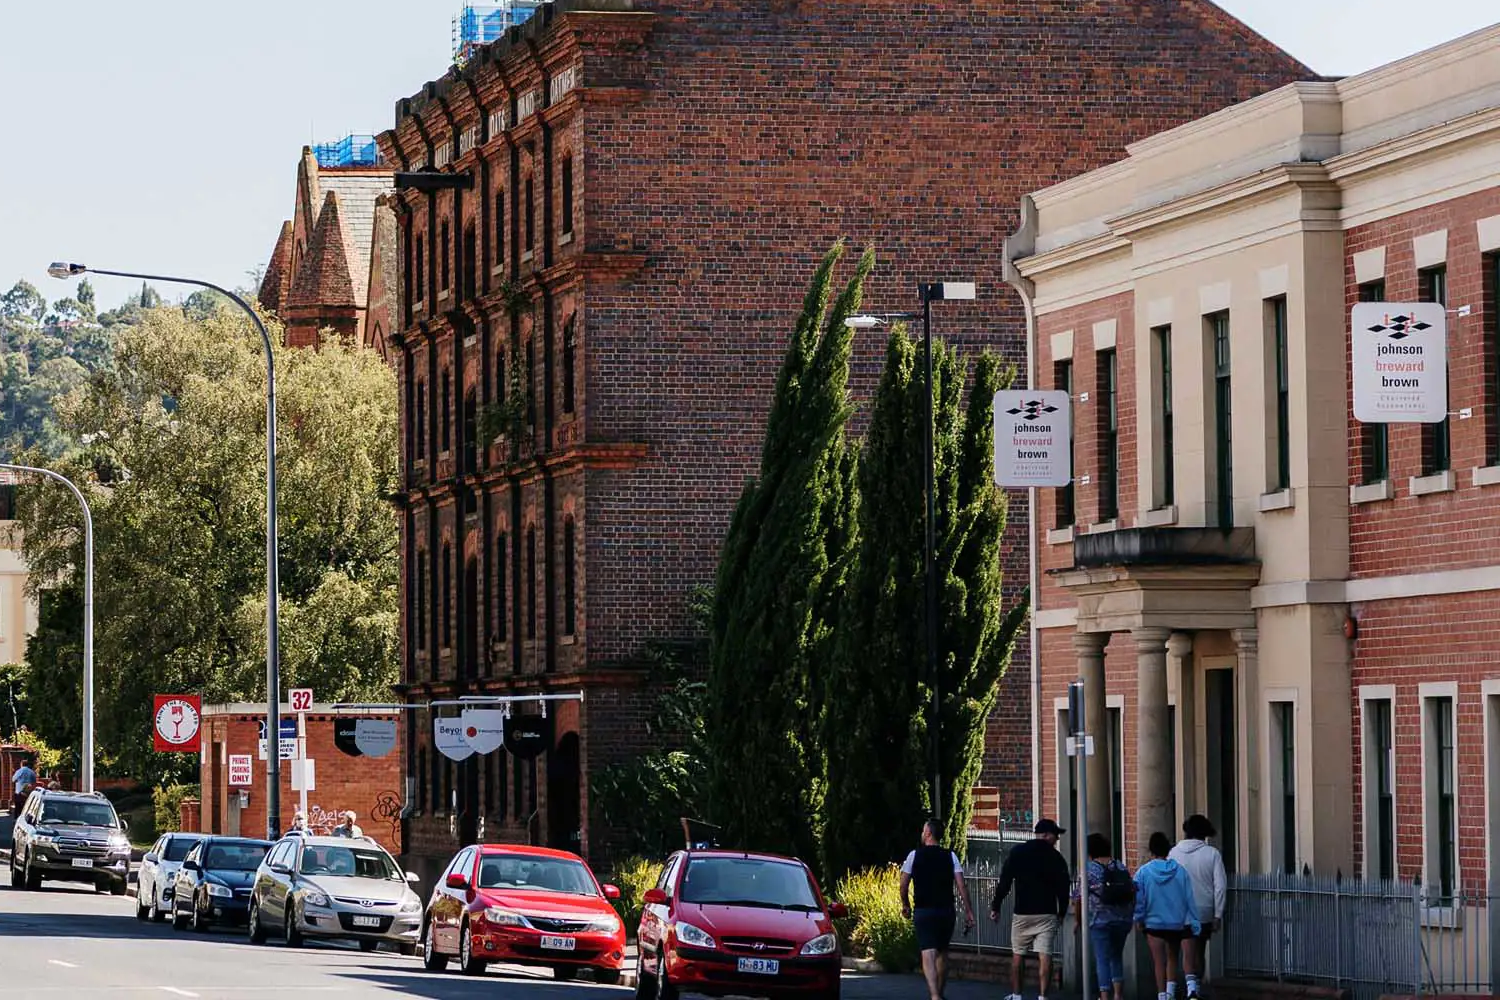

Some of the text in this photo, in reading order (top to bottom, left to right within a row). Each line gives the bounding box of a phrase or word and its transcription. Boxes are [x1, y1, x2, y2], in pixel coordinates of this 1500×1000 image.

[1376, 342, 1424, 357] johnson
[1374, 359, 1425, 373] breward
[1381, 375, 1419, 388] brown
[1014, 422, 1052, 434] johnson
[1012, 437, 1053, 446] breward
[1017, 448, 1048, 459] brown
[292, 691, 311, 710] 32
[231, 774, 250, 782] ONLY
